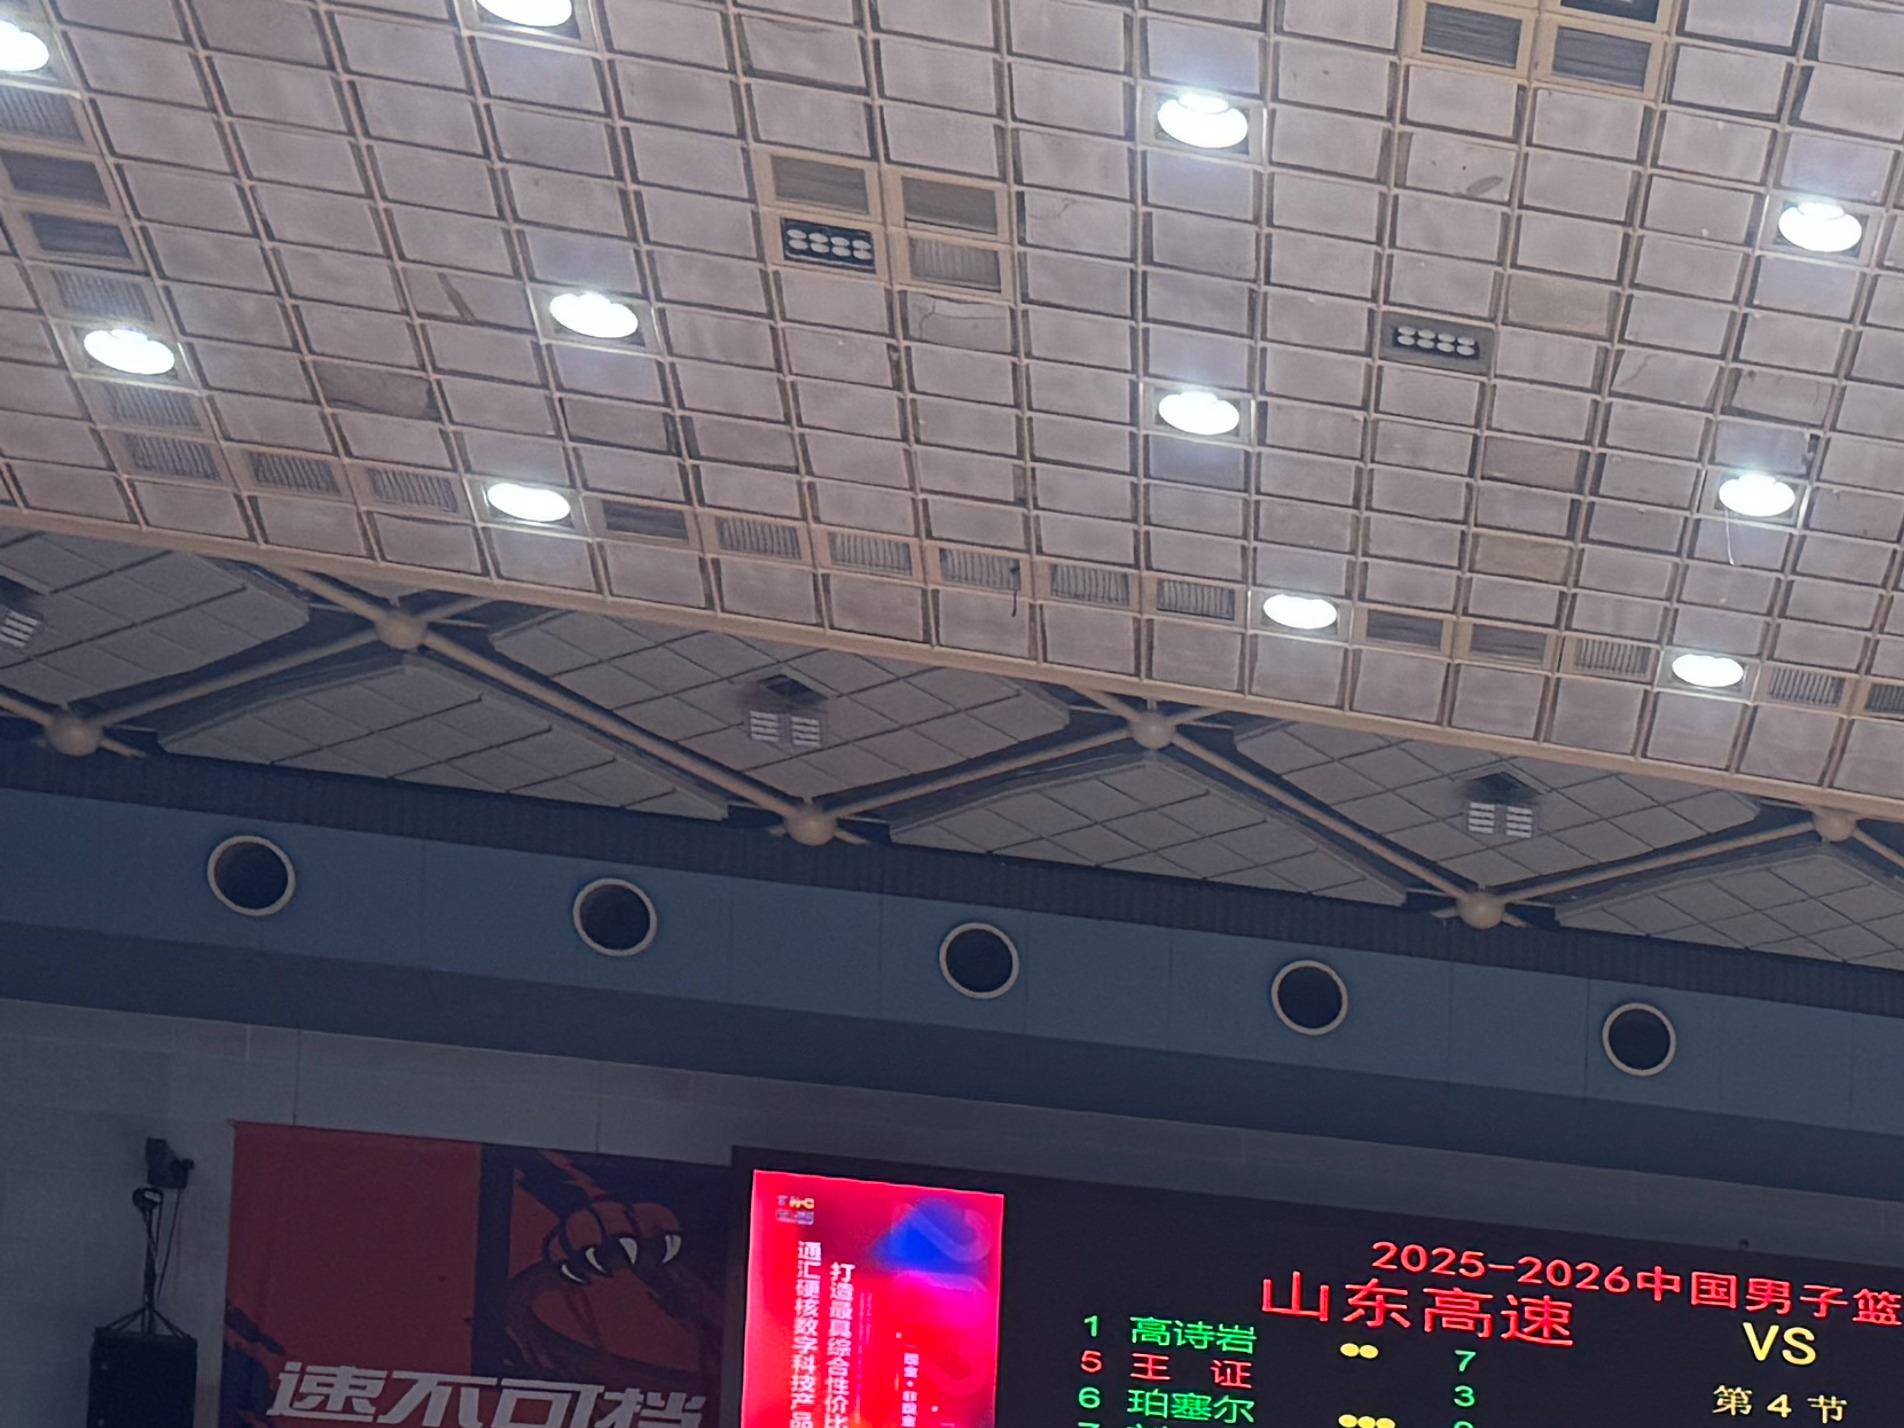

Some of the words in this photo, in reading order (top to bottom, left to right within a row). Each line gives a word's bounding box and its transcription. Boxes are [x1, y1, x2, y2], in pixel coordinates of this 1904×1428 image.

[1261, 1269, 1574, 1348] 山东高速
[1083, 1315, 1099, 1337] 1
[1130, 1316, 1257, 1354] 高诗岩
[1454, 1350, 1476, 1371] 7
[1742, 1324, 1818, 1367] VS
[1078, 1387, 1101, 1409] 6
[1127, 1389, 1255, 1424] 珀塞尔
[1080, 1351, 1102, 1372] 5
[1455, 1385, 1475, 1407] 3
